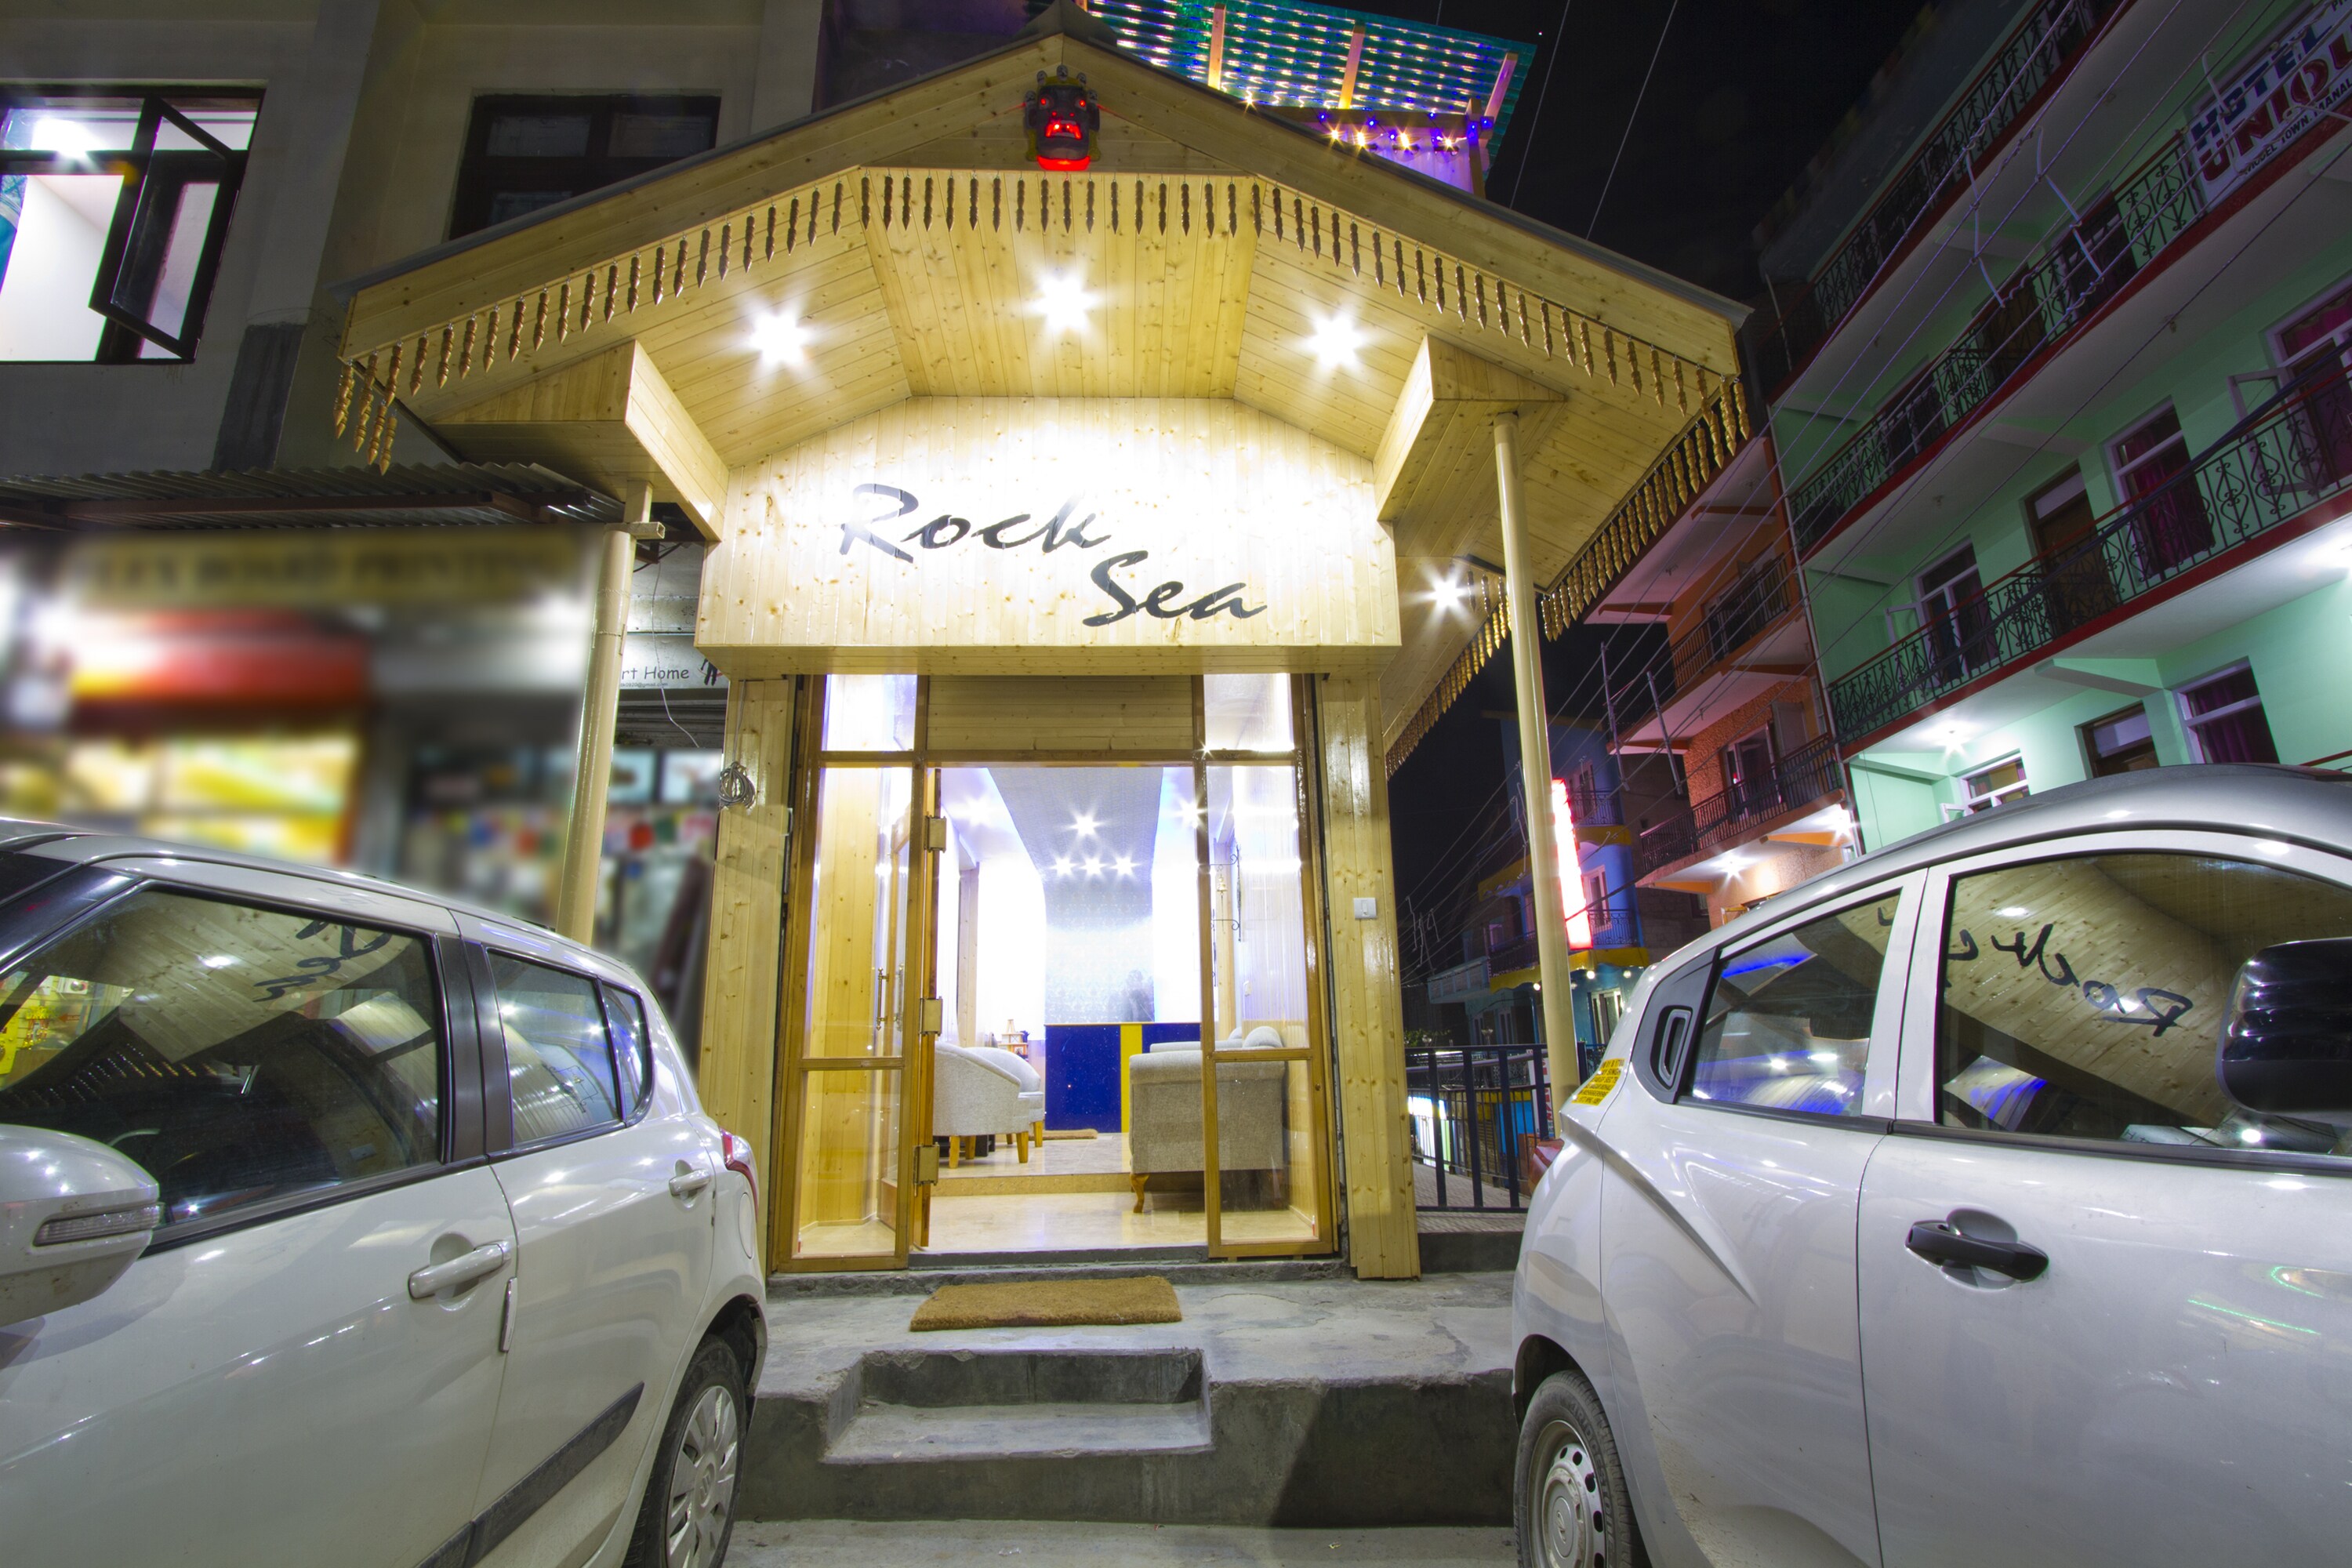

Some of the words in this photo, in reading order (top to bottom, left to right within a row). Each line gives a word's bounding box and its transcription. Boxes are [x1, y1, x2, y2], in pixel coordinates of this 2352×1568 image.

[2190, 26, 2332, 151] HOTEL
[839, 483, 1112, 564] Rock
[1082, 550, 1268, 627] Sea
[622, 668, 637, 680] rt
[644, 666, 689, 680] Home
